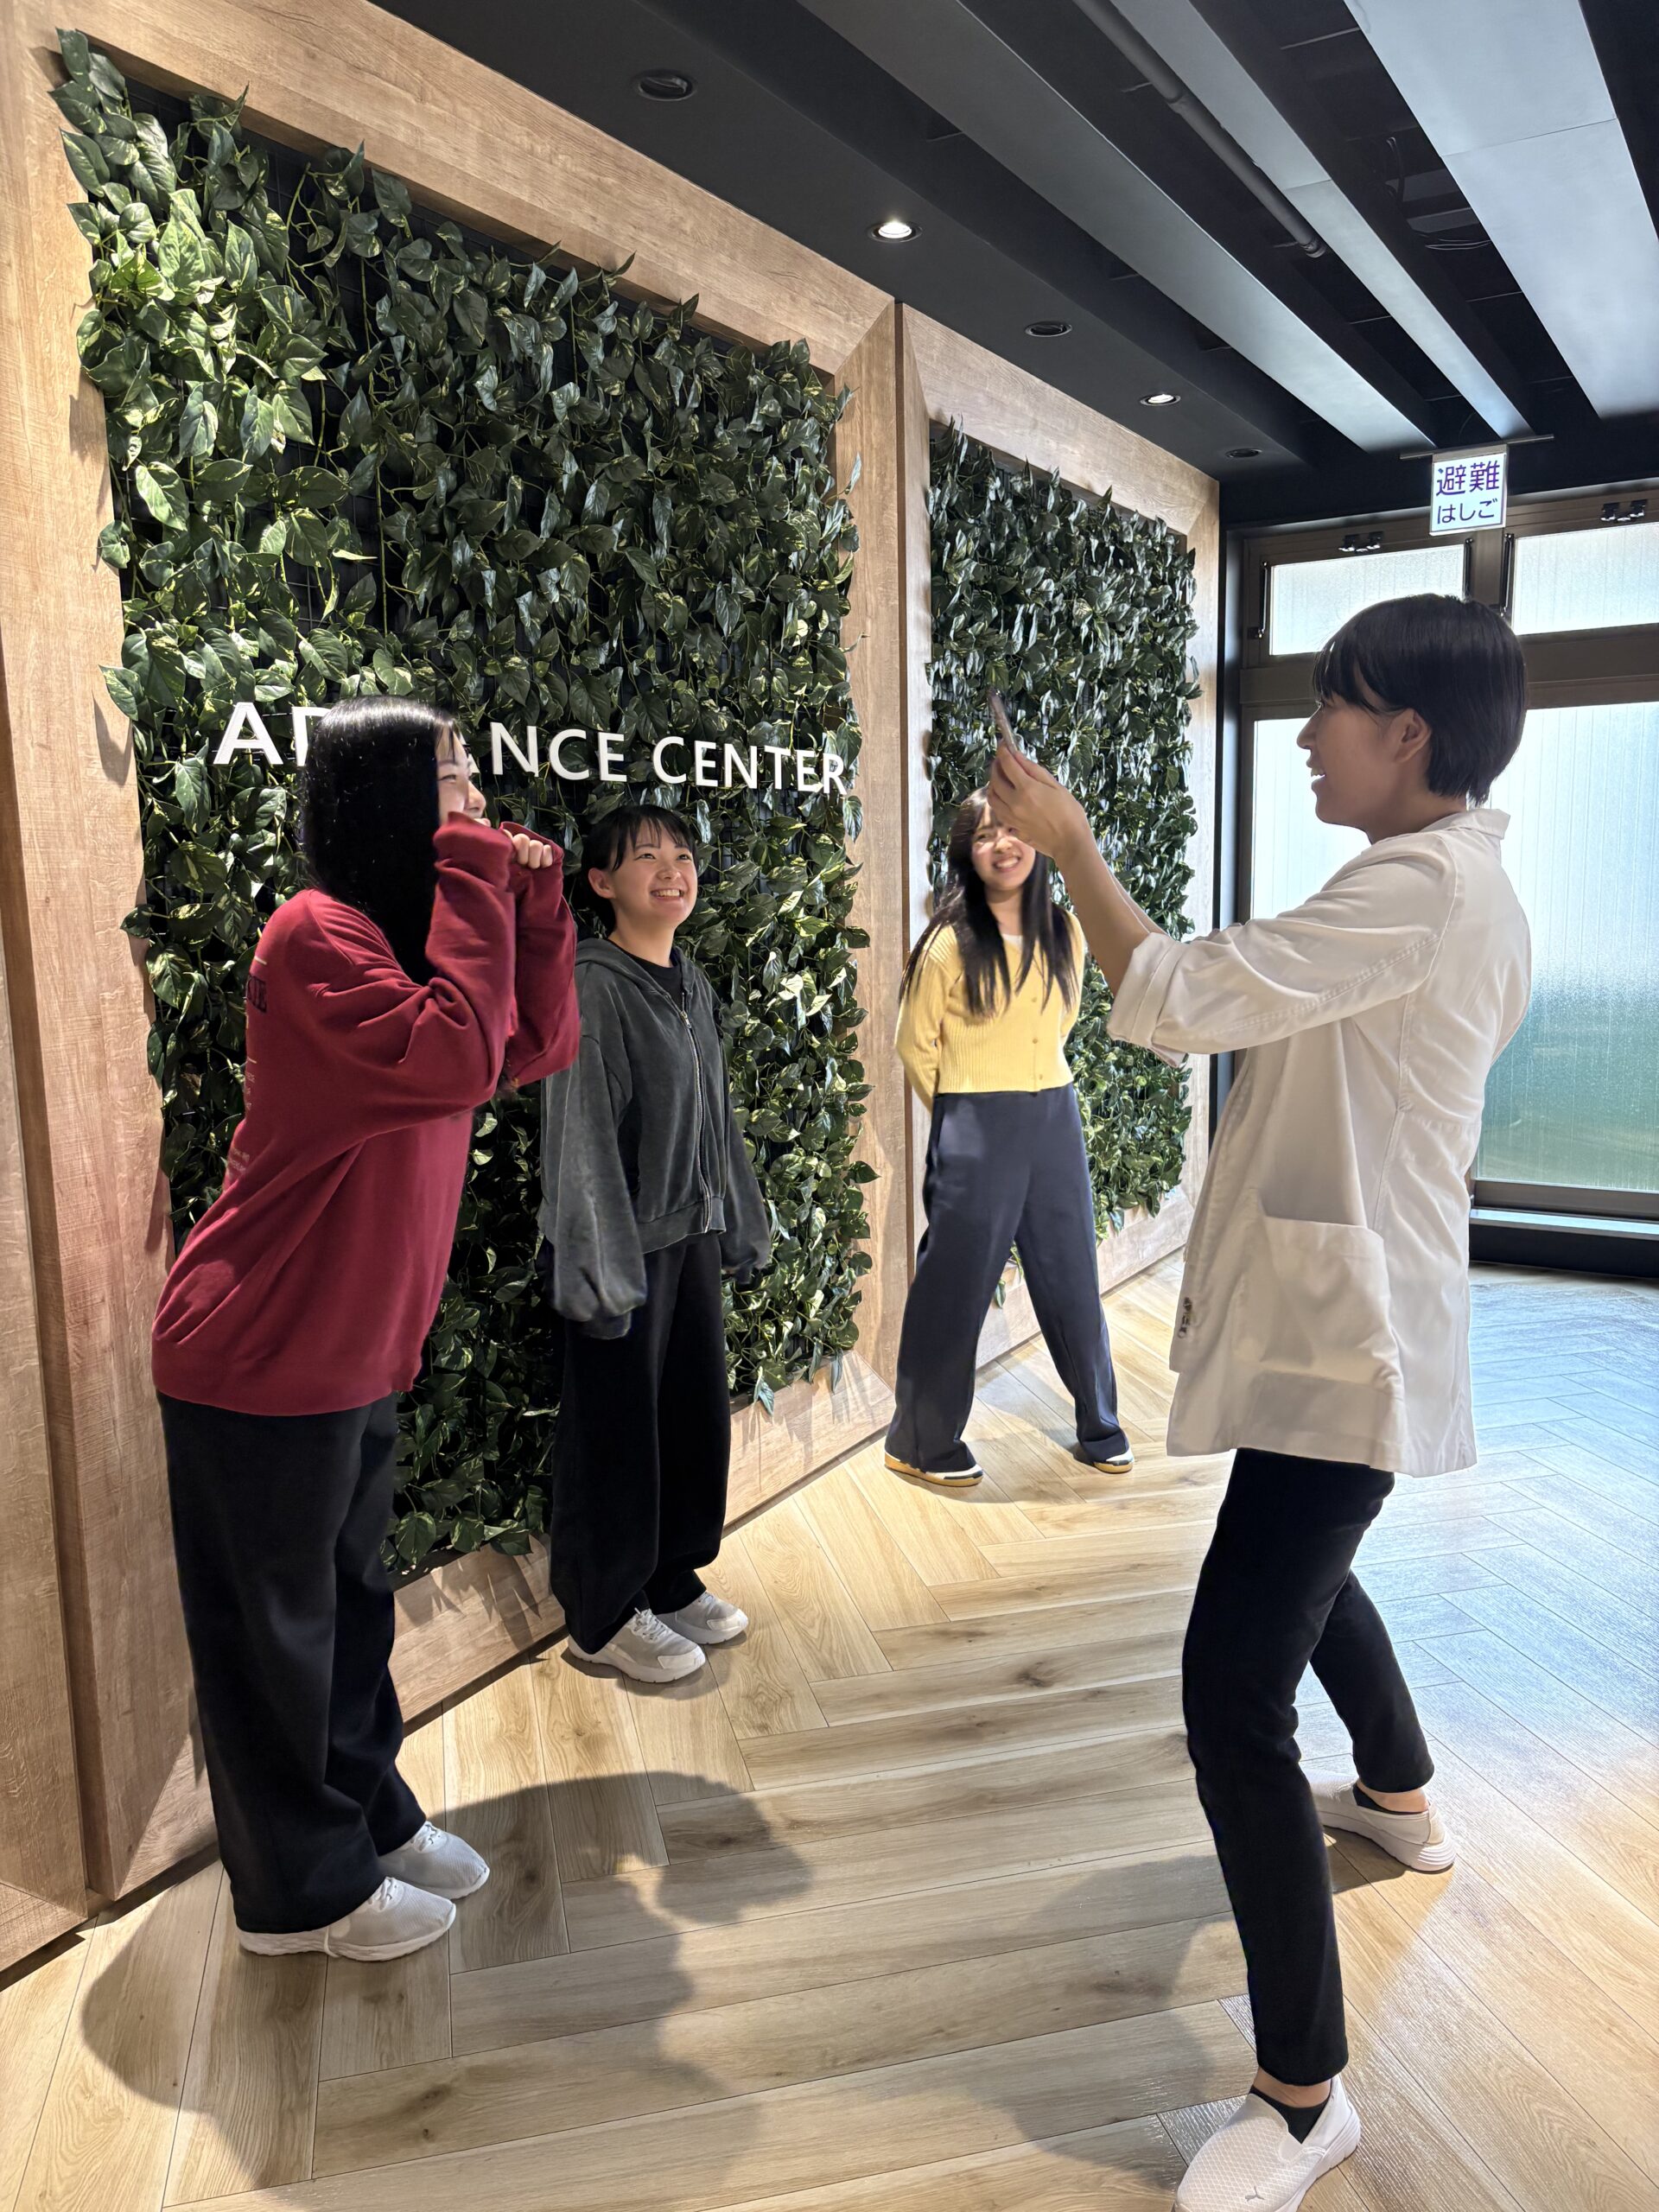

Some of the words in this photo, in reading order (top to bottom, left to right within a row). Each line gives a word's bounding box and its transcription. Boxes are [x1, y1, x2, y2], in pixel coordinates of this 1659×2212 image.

[1436, 461, 1500, 497] 避難
[1437, 498, 1498, 524] はしご
[213, 702, 627, 782] ANCE
[653, 736, 848, 795] CENTER
